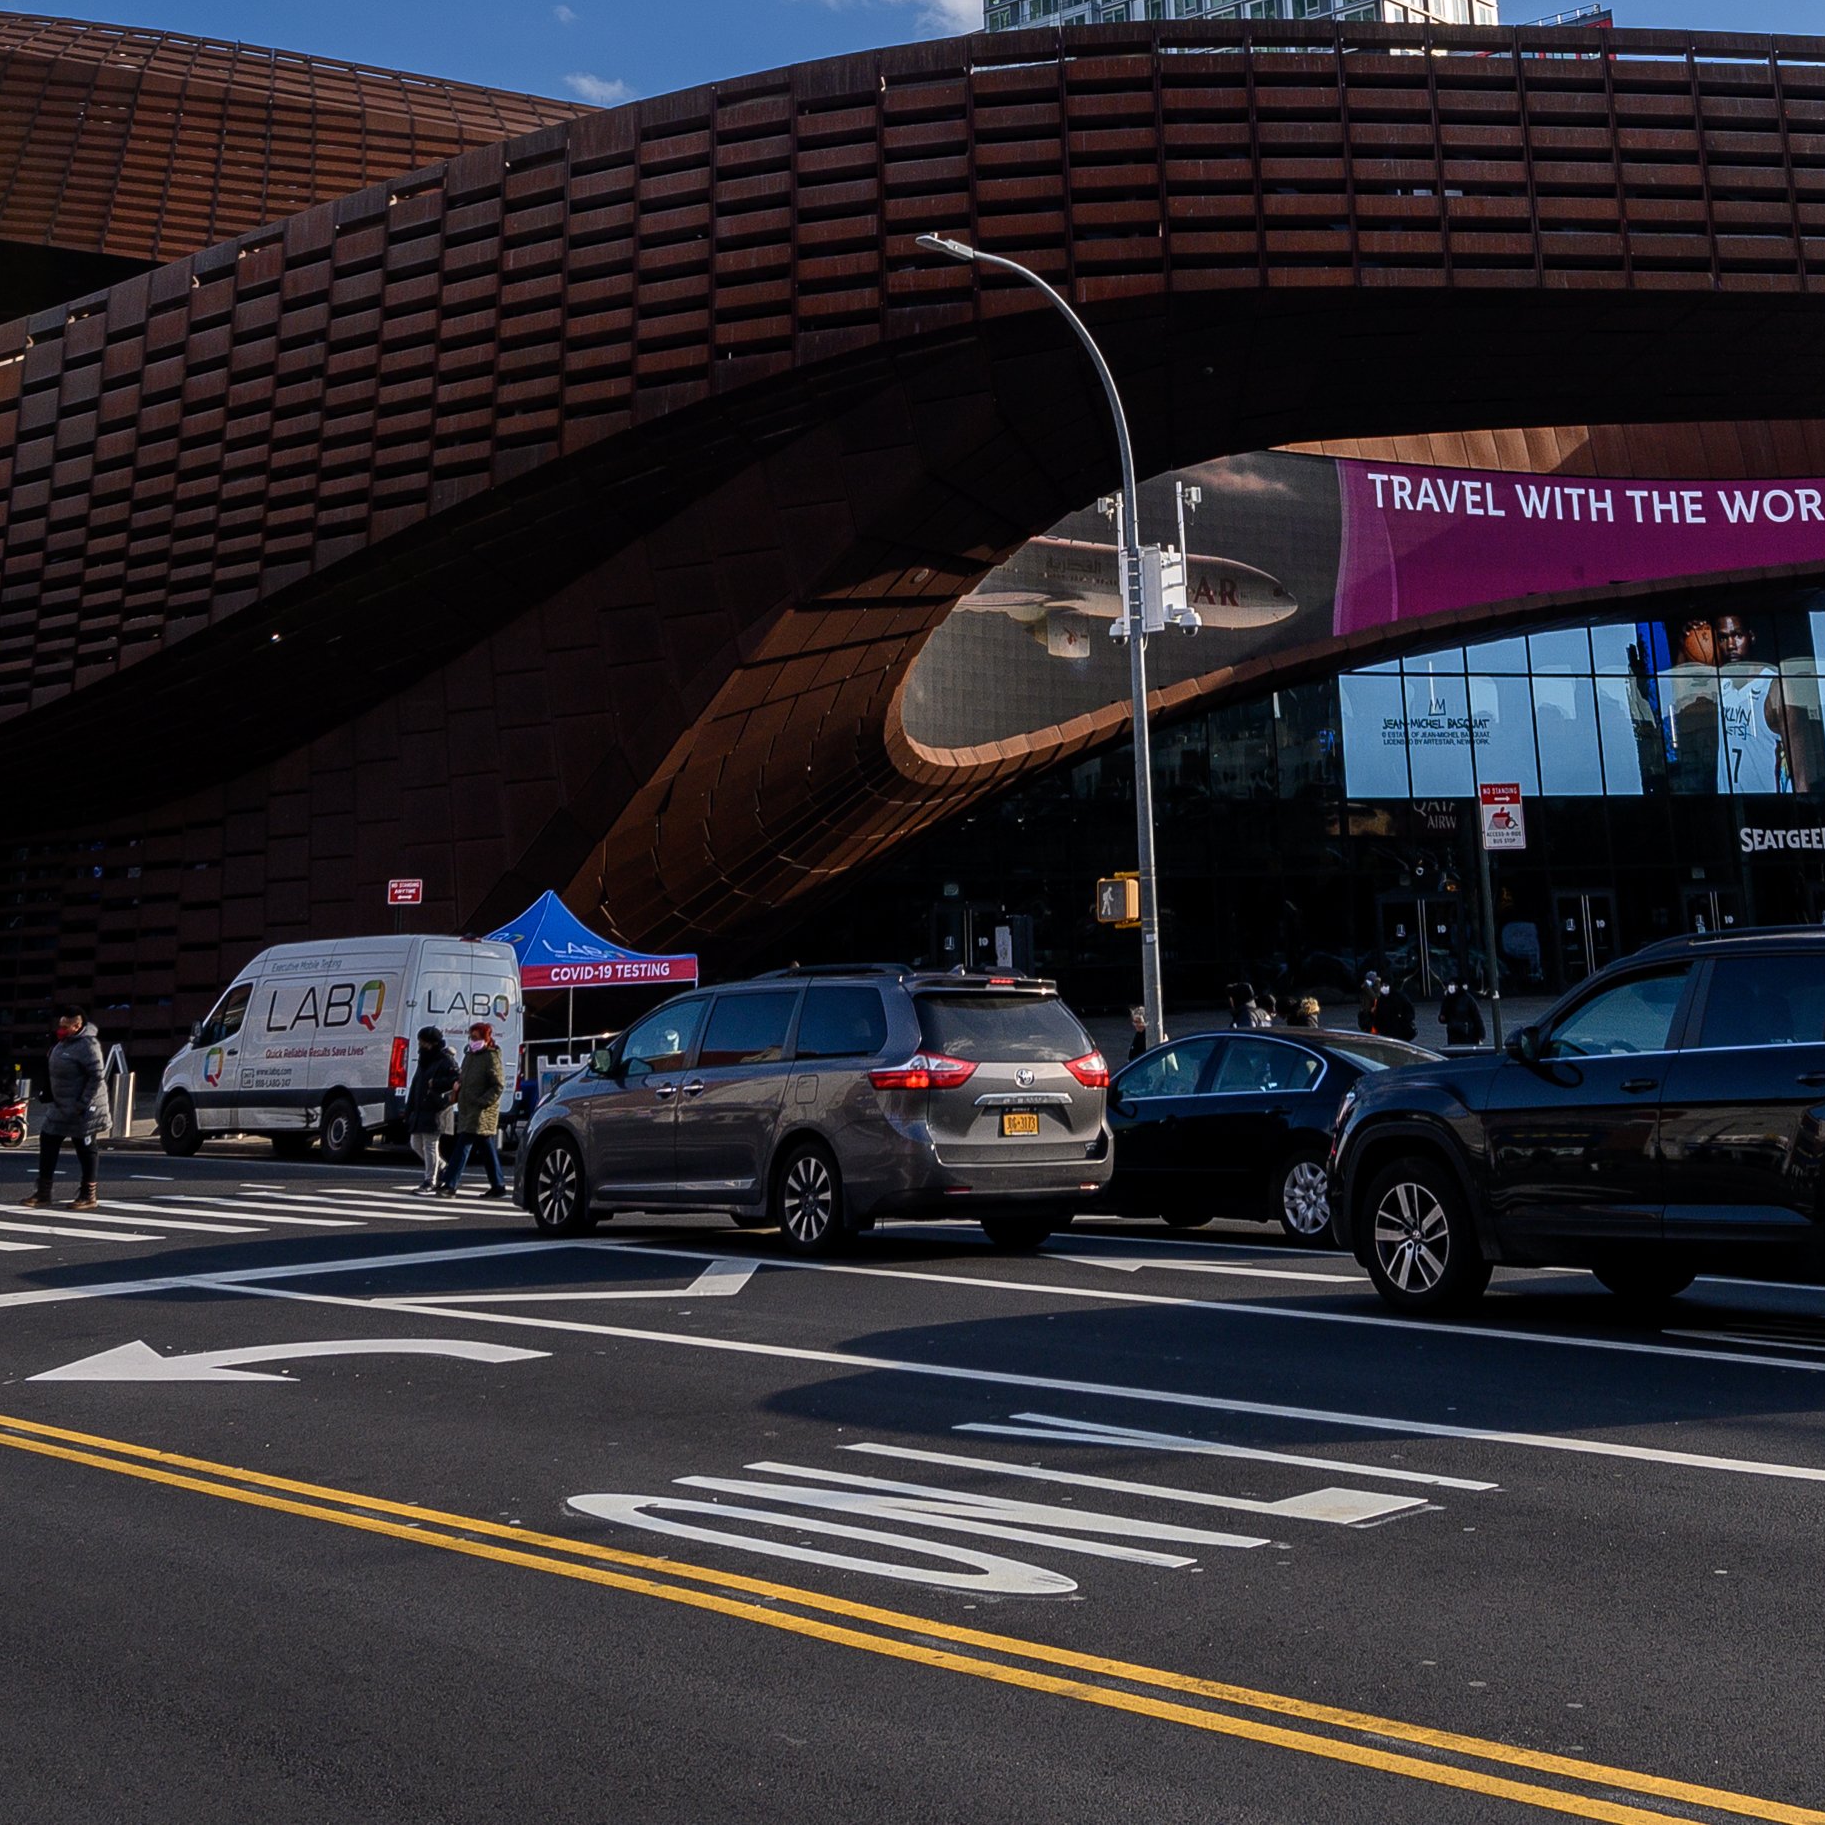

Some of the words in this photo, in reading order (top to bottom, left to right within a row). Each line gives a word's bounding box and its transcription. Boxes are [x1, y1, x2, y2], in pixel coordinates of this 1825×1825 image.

[1368, 474, 1506, 517] TRAVEL
[1516, 484, 1613, 522] WITH
[1626, 490, 1706, 524] THE
[1447, 717, 1490, 732] BASQUIAT
[1724, 705, 1751, 726] KLYN
[1732, 748, 1742, 783] 7
[1492, 786, 1518, 794] STANDING
[301, 961, 319, 970] Mobile
[550, 966, 612, 981] COVID-19
[616, 962, 670, 978] TESTING
[266, 979, 385, 1032] LABQ
[427, 990, 509, 1022] LABQ
[266, 1048, 282, 1059] Quick
[283, 1048, 307, 1058] Reliable
[309, 1047, 331, 1057] Results
[332, 1046, 346, 1056] Save
[567, 1411, 1499, 1594] ONLY
